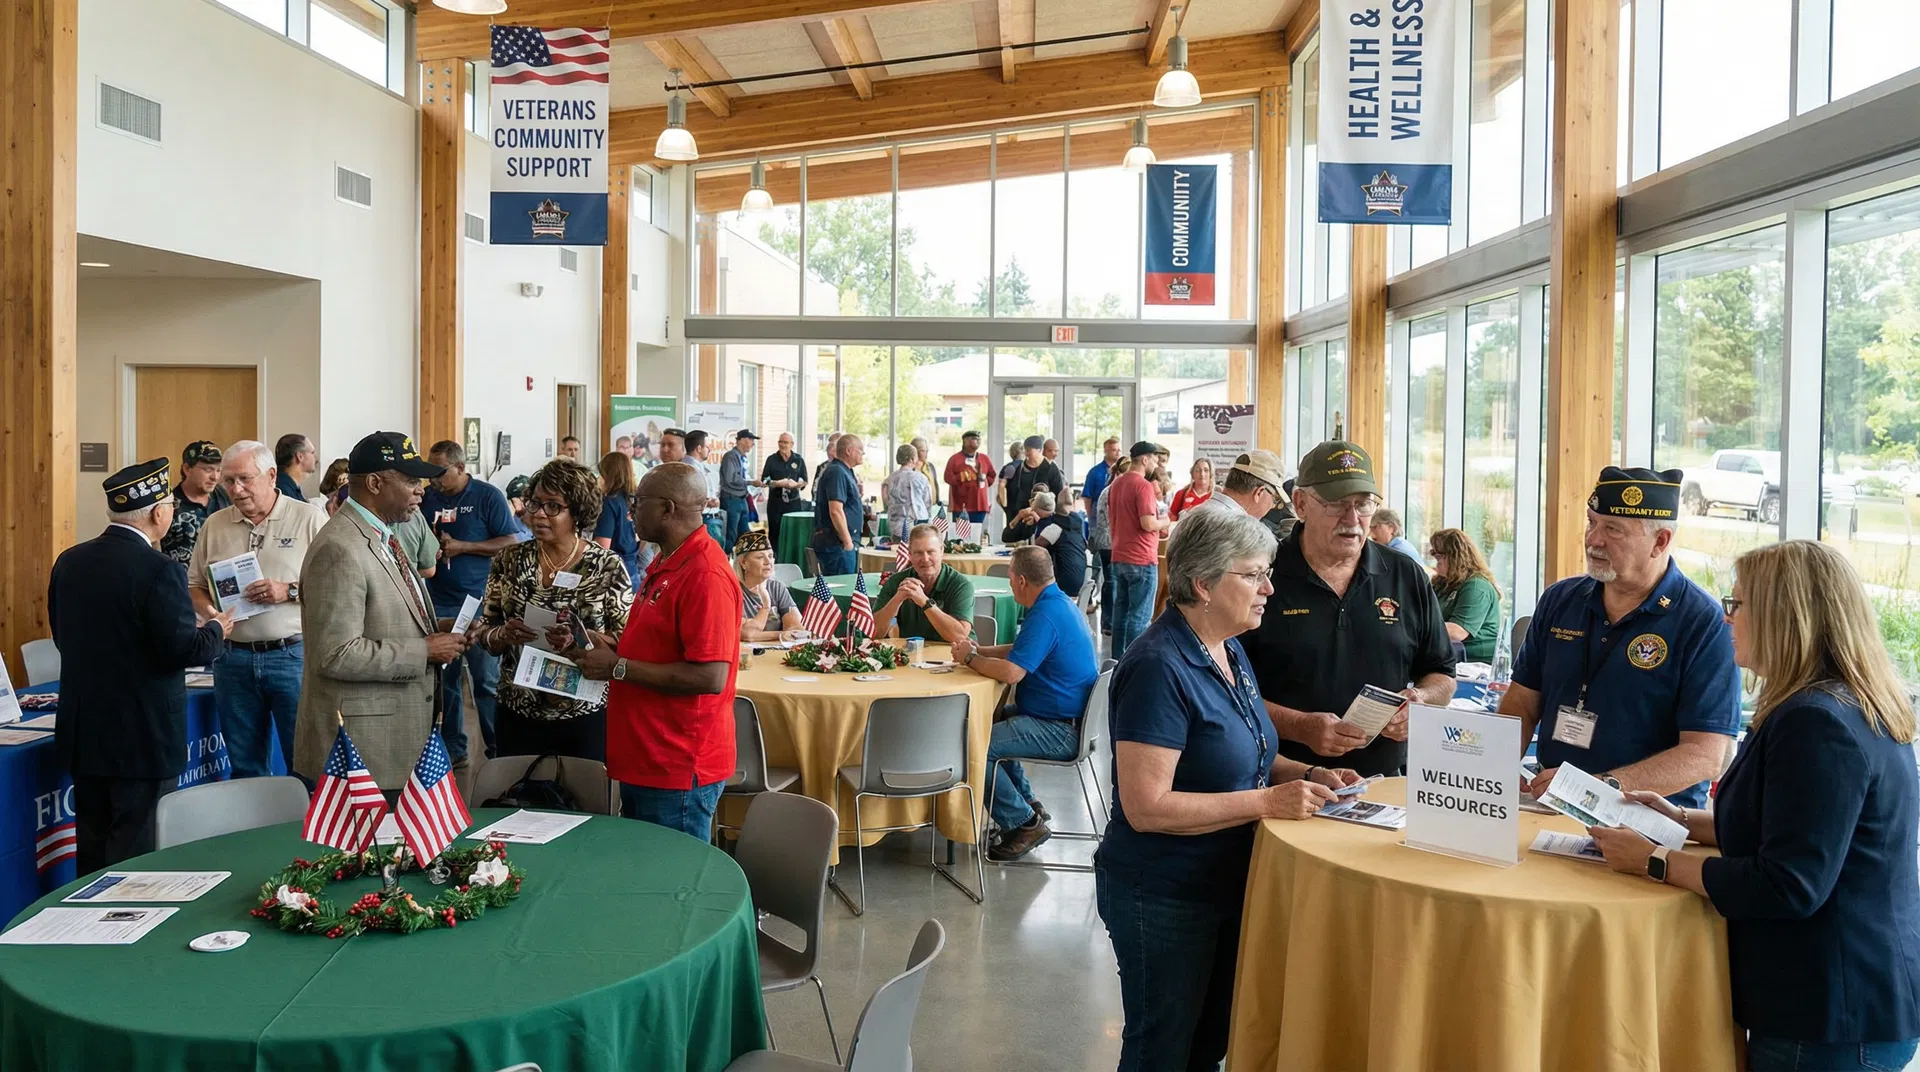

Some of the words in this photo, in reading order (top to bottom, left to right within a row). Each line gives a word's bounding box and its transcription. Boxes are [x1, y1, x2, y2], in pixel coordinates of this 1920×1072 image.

[1349, 8, 1381, 28] &
[1390, 0, 1424, 141] WELLNESS
[1348, 39, 1380, 138] HEALTH
[503, 99, 596, 120] VETERANS
[494, 128, 605, 149] COMMUNITY
[506, 157, 592, 178] SUPPORT
[1056, 327, 1075, 342] EXIT
[1422, 768, 1503, 796] WELLNESS
[1417, 790, 1508, 820] RESOURCES
